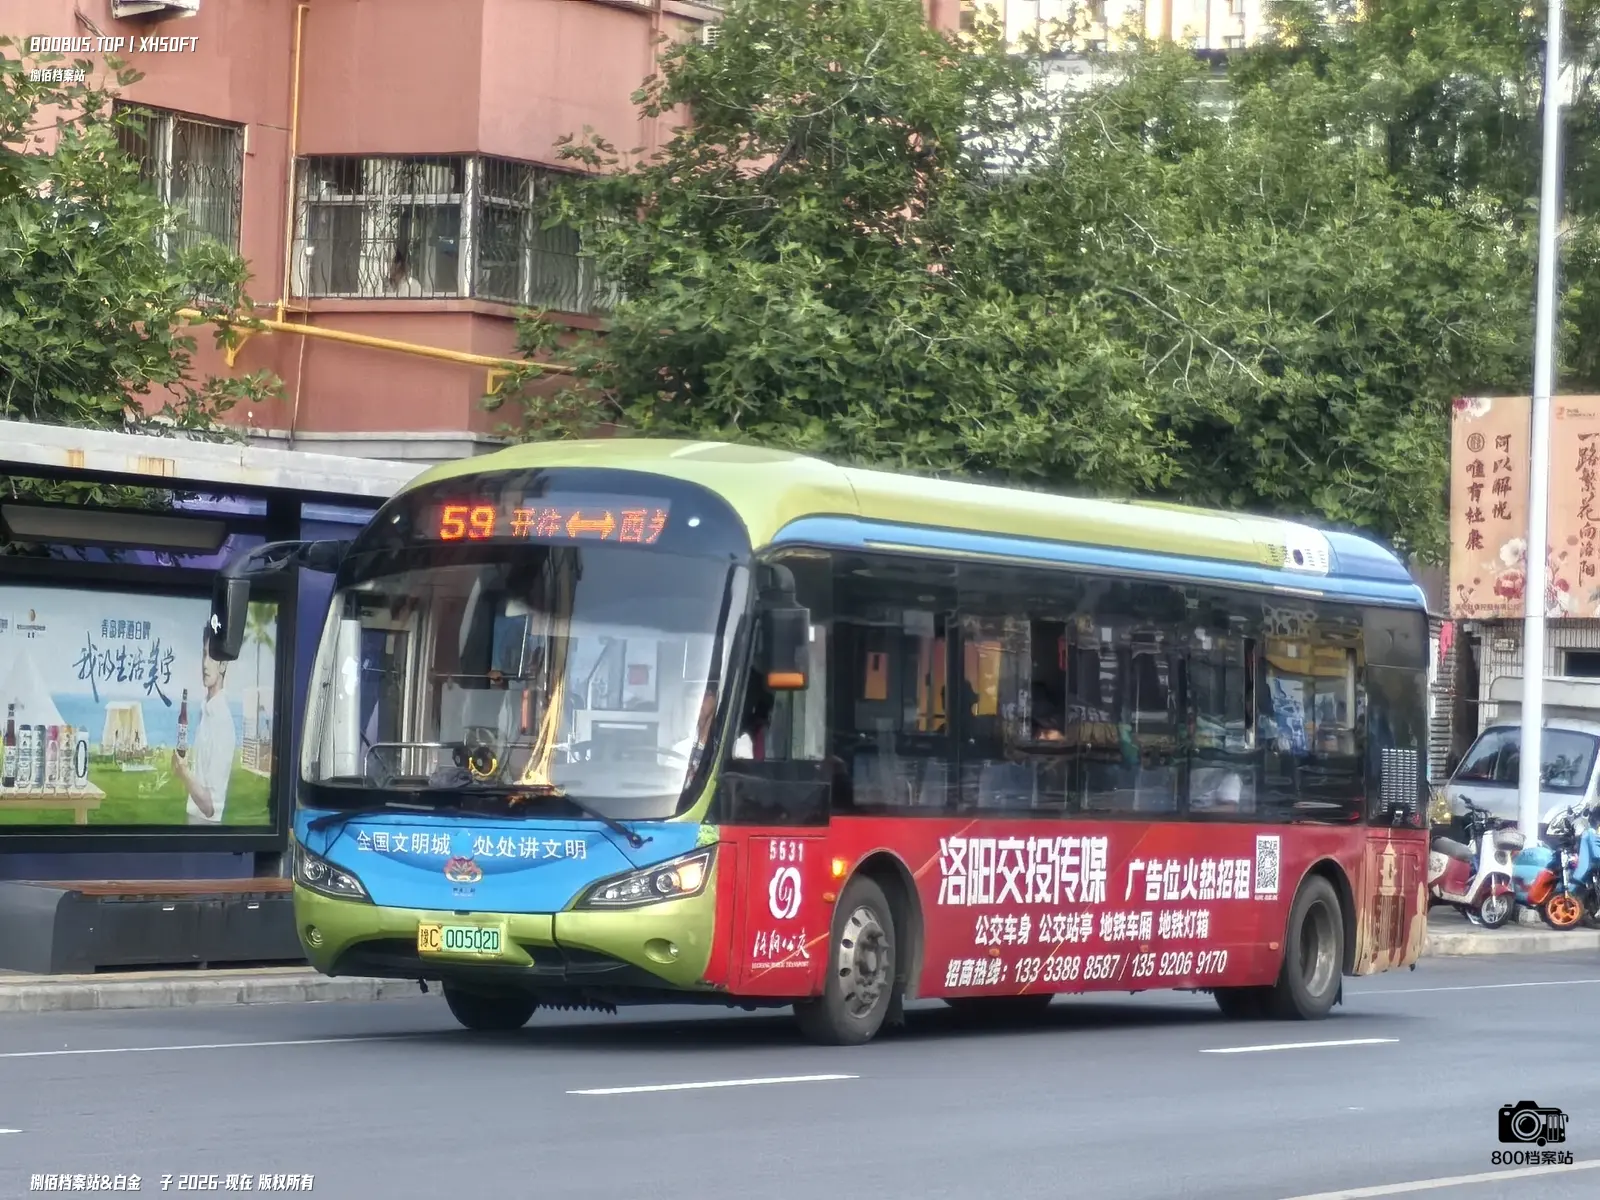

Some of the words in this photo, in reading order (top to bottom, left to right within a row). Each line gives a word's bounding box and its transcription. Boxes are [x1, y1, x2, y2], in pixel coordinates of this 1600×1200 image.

[440, 504, 496, 540] 59
[1465, 458, 1486, 551] 唯有杜康
[72, 631, 176, 708] 我的生活美学
[356, 830, 450, 855] 全国文明城
[472, 834, 588, 860] 处处讲文明
[937, 836, 1108, 906] 洛阳交投传媒
[1125, 857, 1252, 902] 广告位火热招租
[974, 913, 1032, 946] 公交车身
[1038, 912, 1094, 943] 公交站亭
[1099, 910, 1153, 942] 地铁车厢
[1158, 909, 1210, 940] 地铁灯箱
[1015, 957, 1041, 983] 133
[1043, 955, 1081, 982] 3388
[1083, 954, 1121, 980] 8587
[1131, 952, 1157, 978] 135
[1158, 951, 1194, 977] 9206
[1195, 949, 1229, 975] 9170
